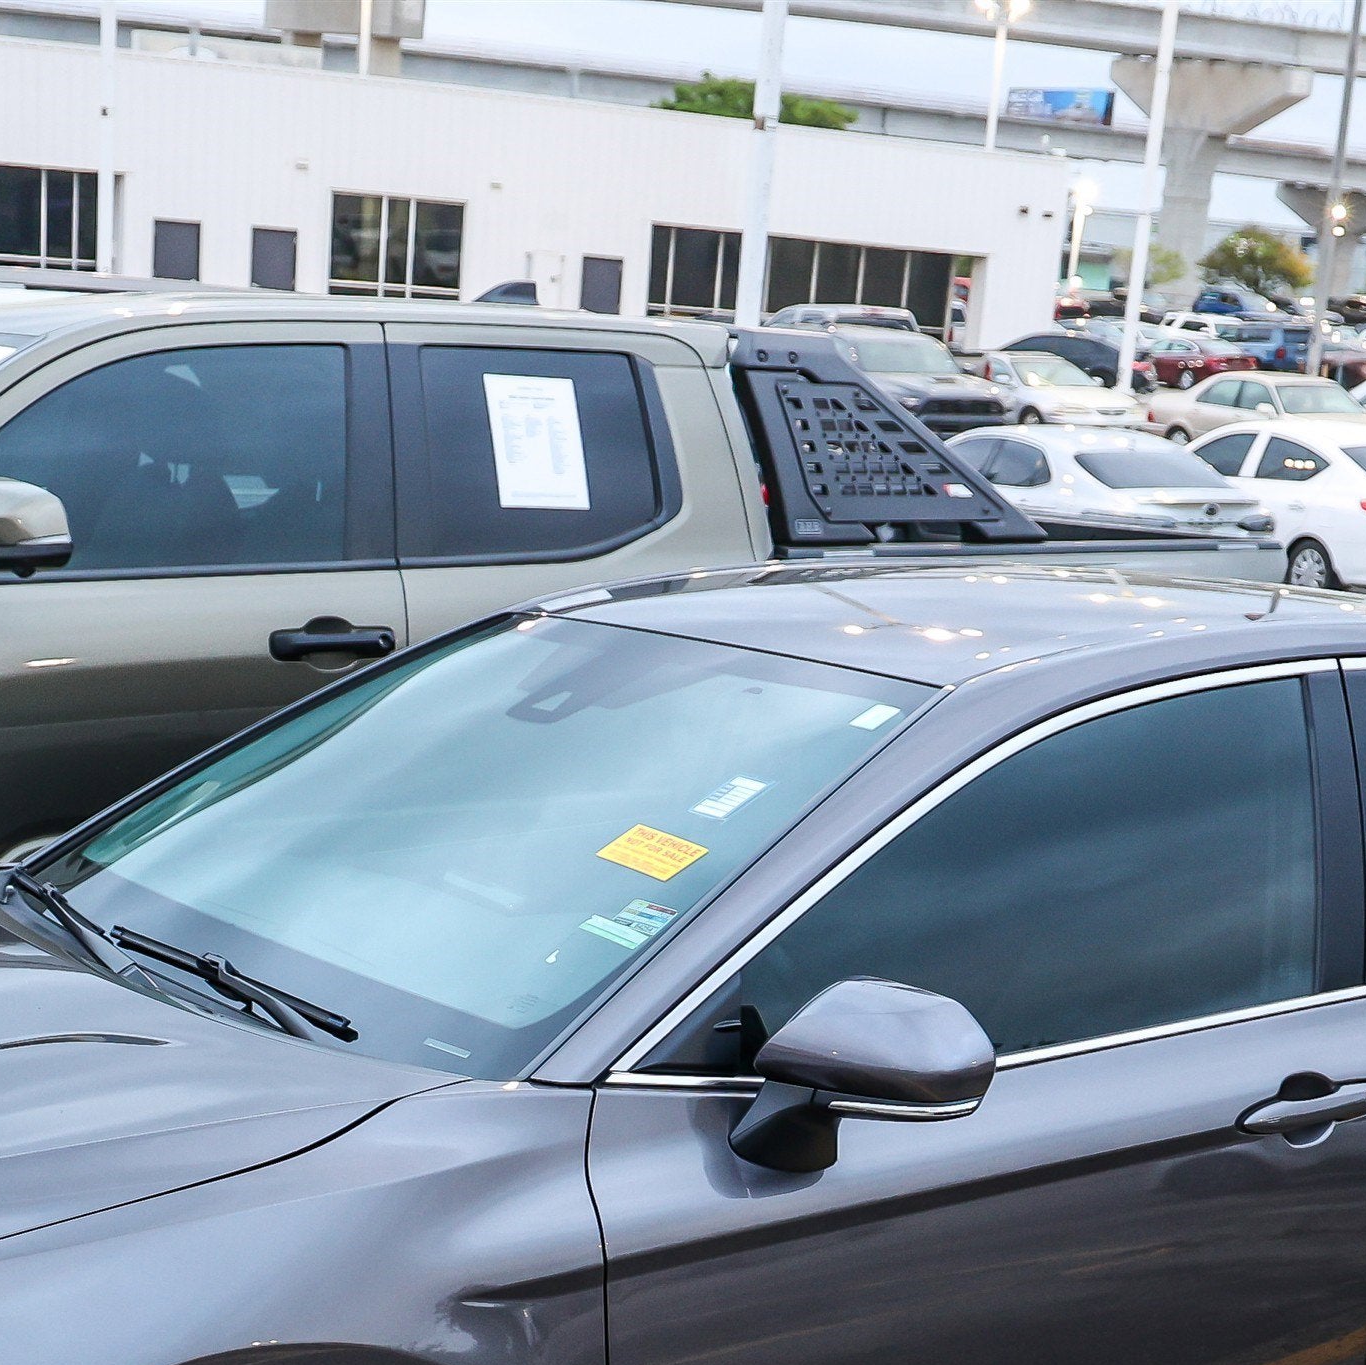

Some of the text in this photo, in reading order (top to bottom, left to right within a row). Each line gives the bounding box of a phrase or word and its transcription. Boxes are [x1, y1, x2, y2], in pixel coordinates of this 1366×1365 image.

[625, 836, 645, 847] NOT
[644, 843, 664, 853] FOR
[661, 850, 688, 863] SALE
[633, 827, 701, 857] THIS VEHICLE
